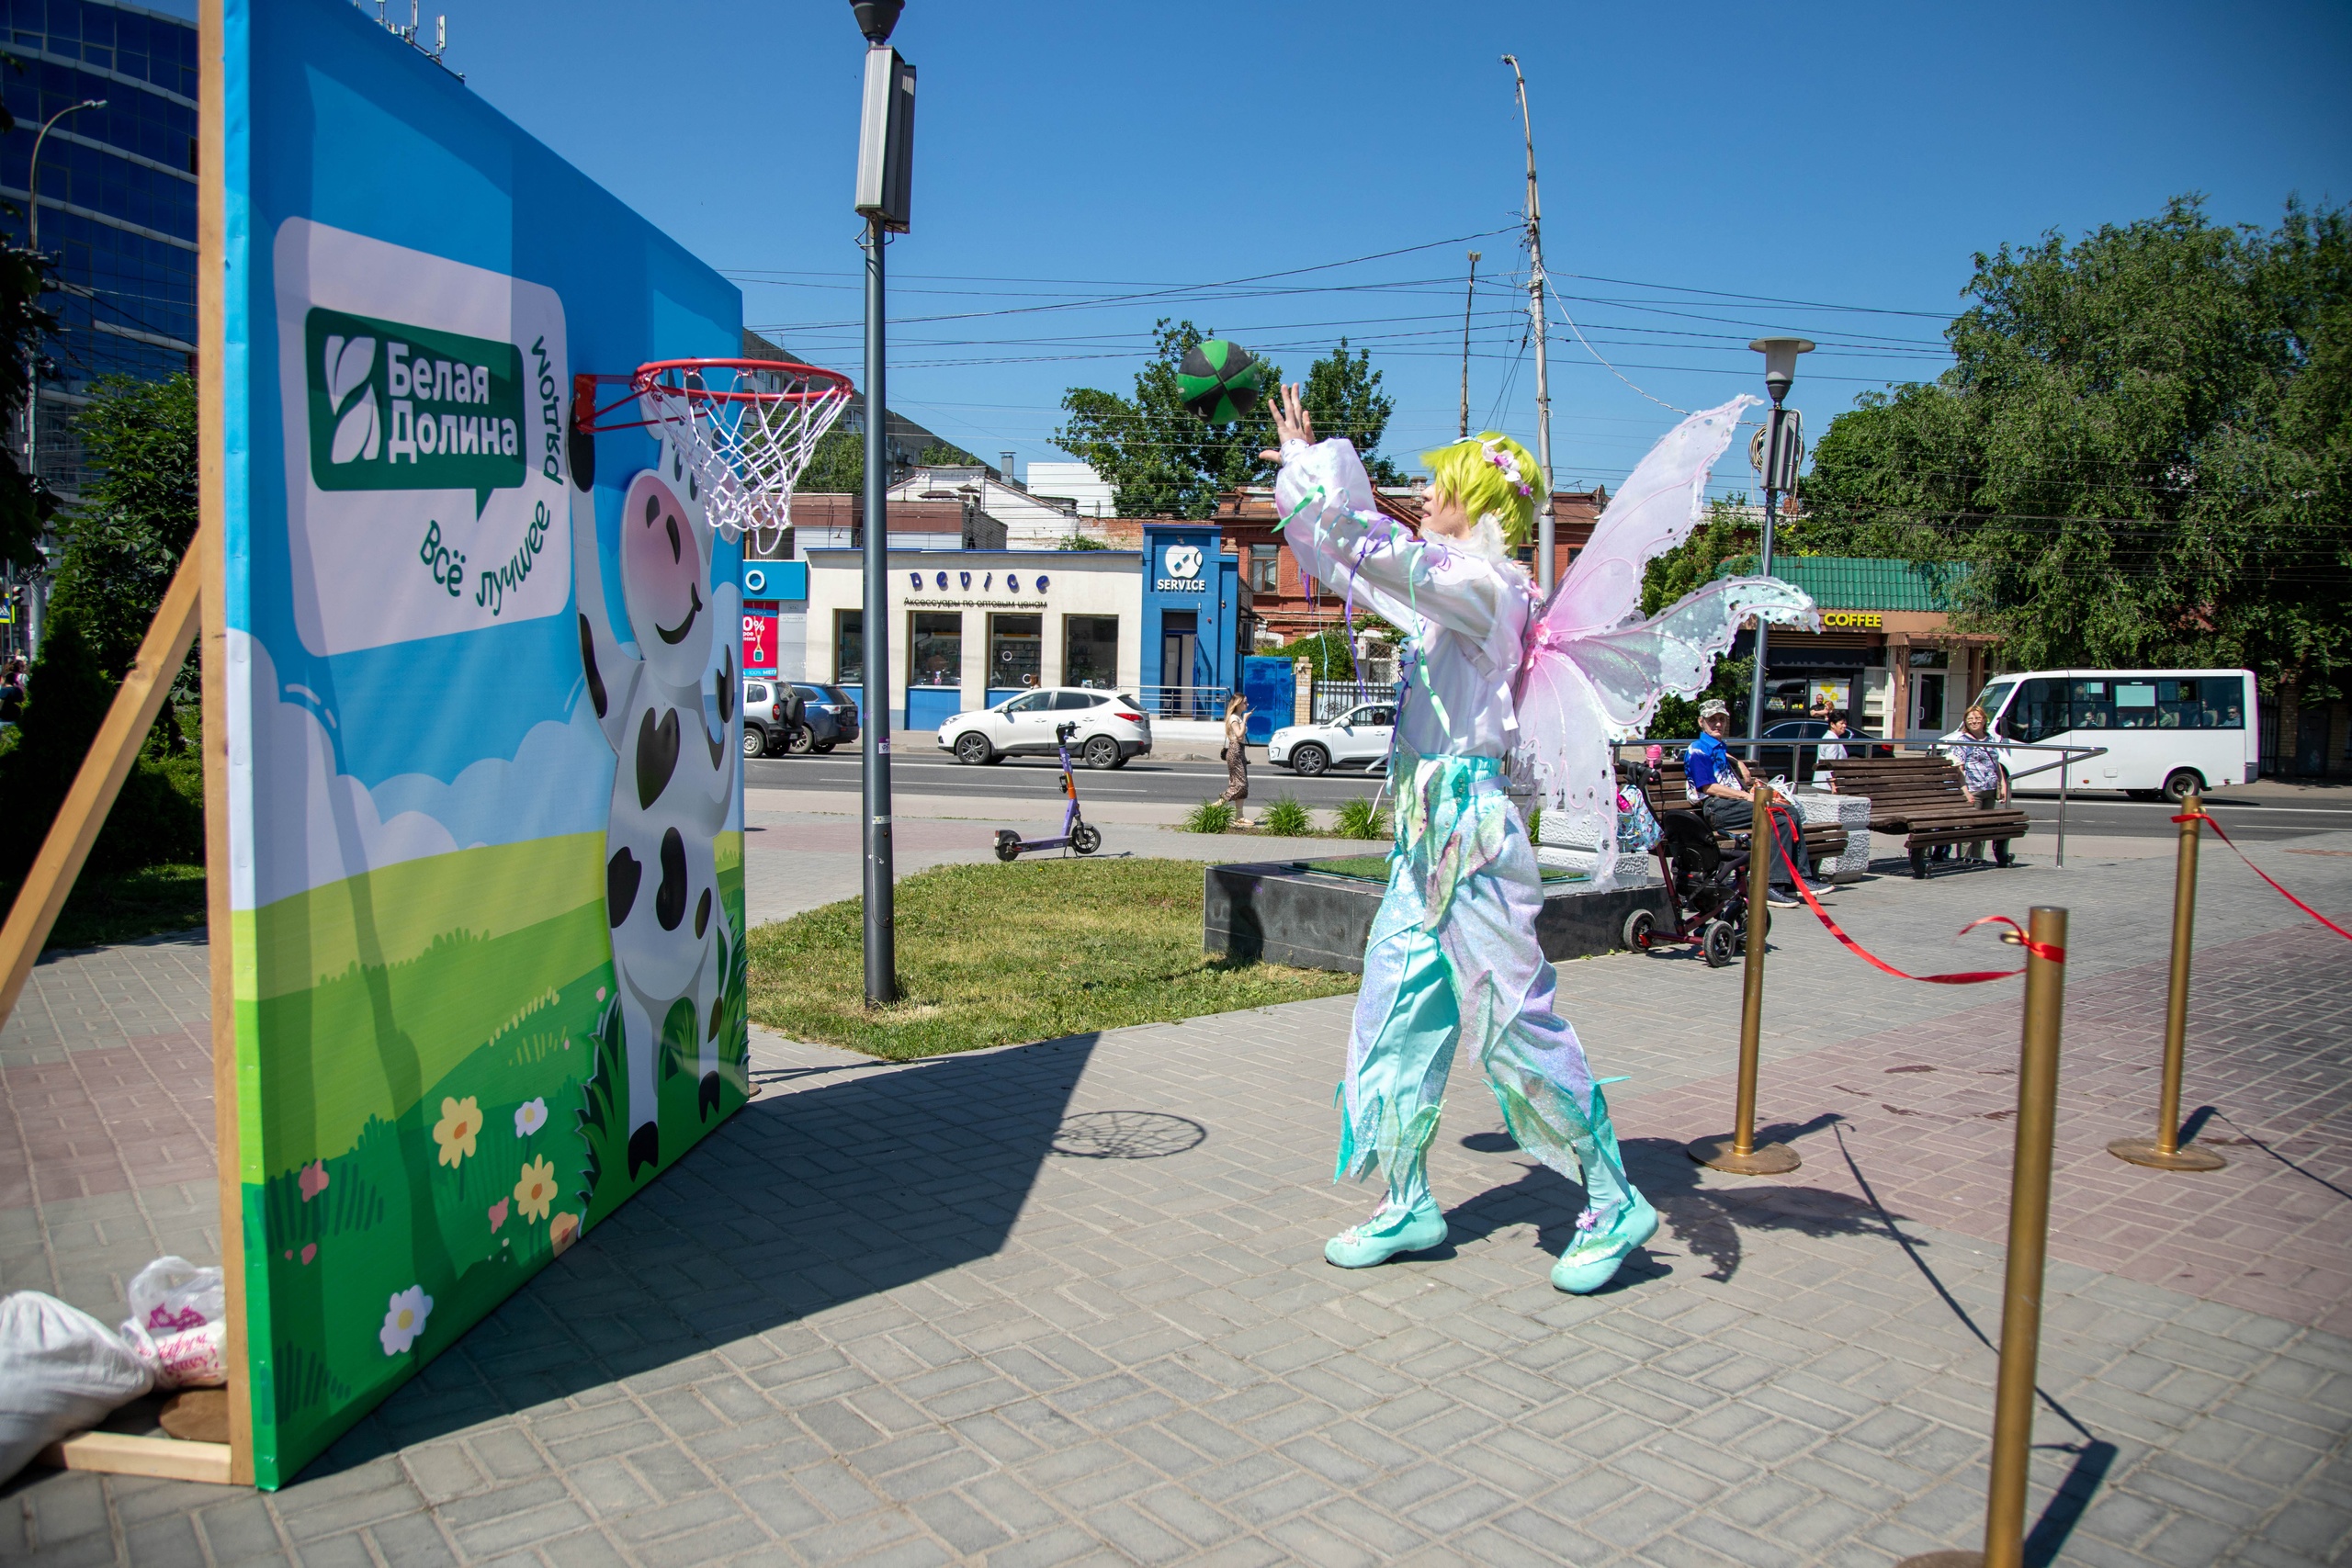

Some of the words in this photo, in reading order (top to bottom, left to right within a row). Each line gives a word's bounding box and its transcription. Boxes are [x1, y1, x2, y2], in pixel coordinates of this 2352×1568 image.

[387, 341, 489, 404] Белая
[389, 400, 518, 464] Долина
[420, 519, 467, 597] Всё
[476, 500, 550, 616] лучшее
[531, 335, 564, 485] рядом
[904, 597, 960, 609] Аксессуары
[963, 600, 975, 608] по
[976, 600, 1014, 609] оптовым
[1017, 600, 1048, 610] ценам
[1157, 580, 1205, 591] SERVICE
[1824, 613, 1882, 627] COFFEE
